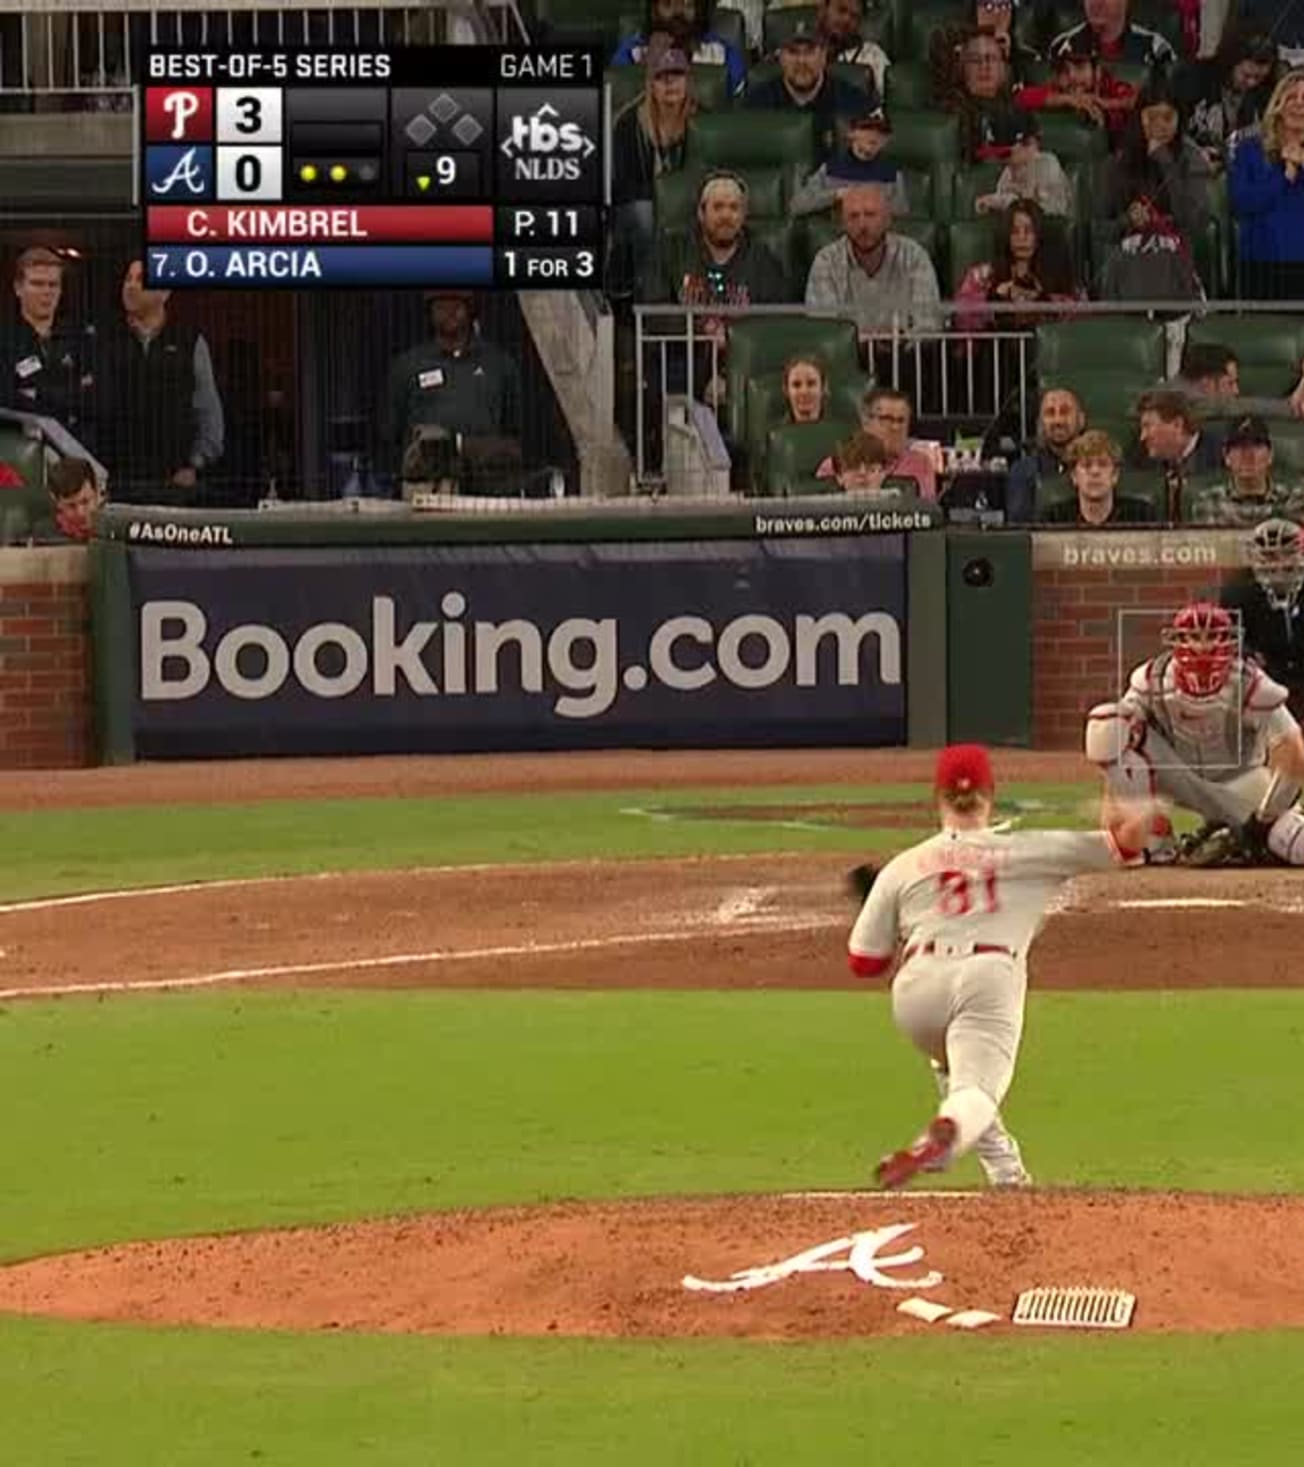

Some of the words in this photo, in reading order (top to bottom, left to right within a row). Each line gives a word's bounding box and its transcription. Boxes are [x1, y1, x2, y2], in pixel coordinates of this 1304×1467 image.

[129, 523, 234, 545] #AsOneATL
[756, 512, 933, 533] braves.com/tickets
[1063, 542, 1217, 566] braves.com
[140, 591, 901, 719] Booking.com
